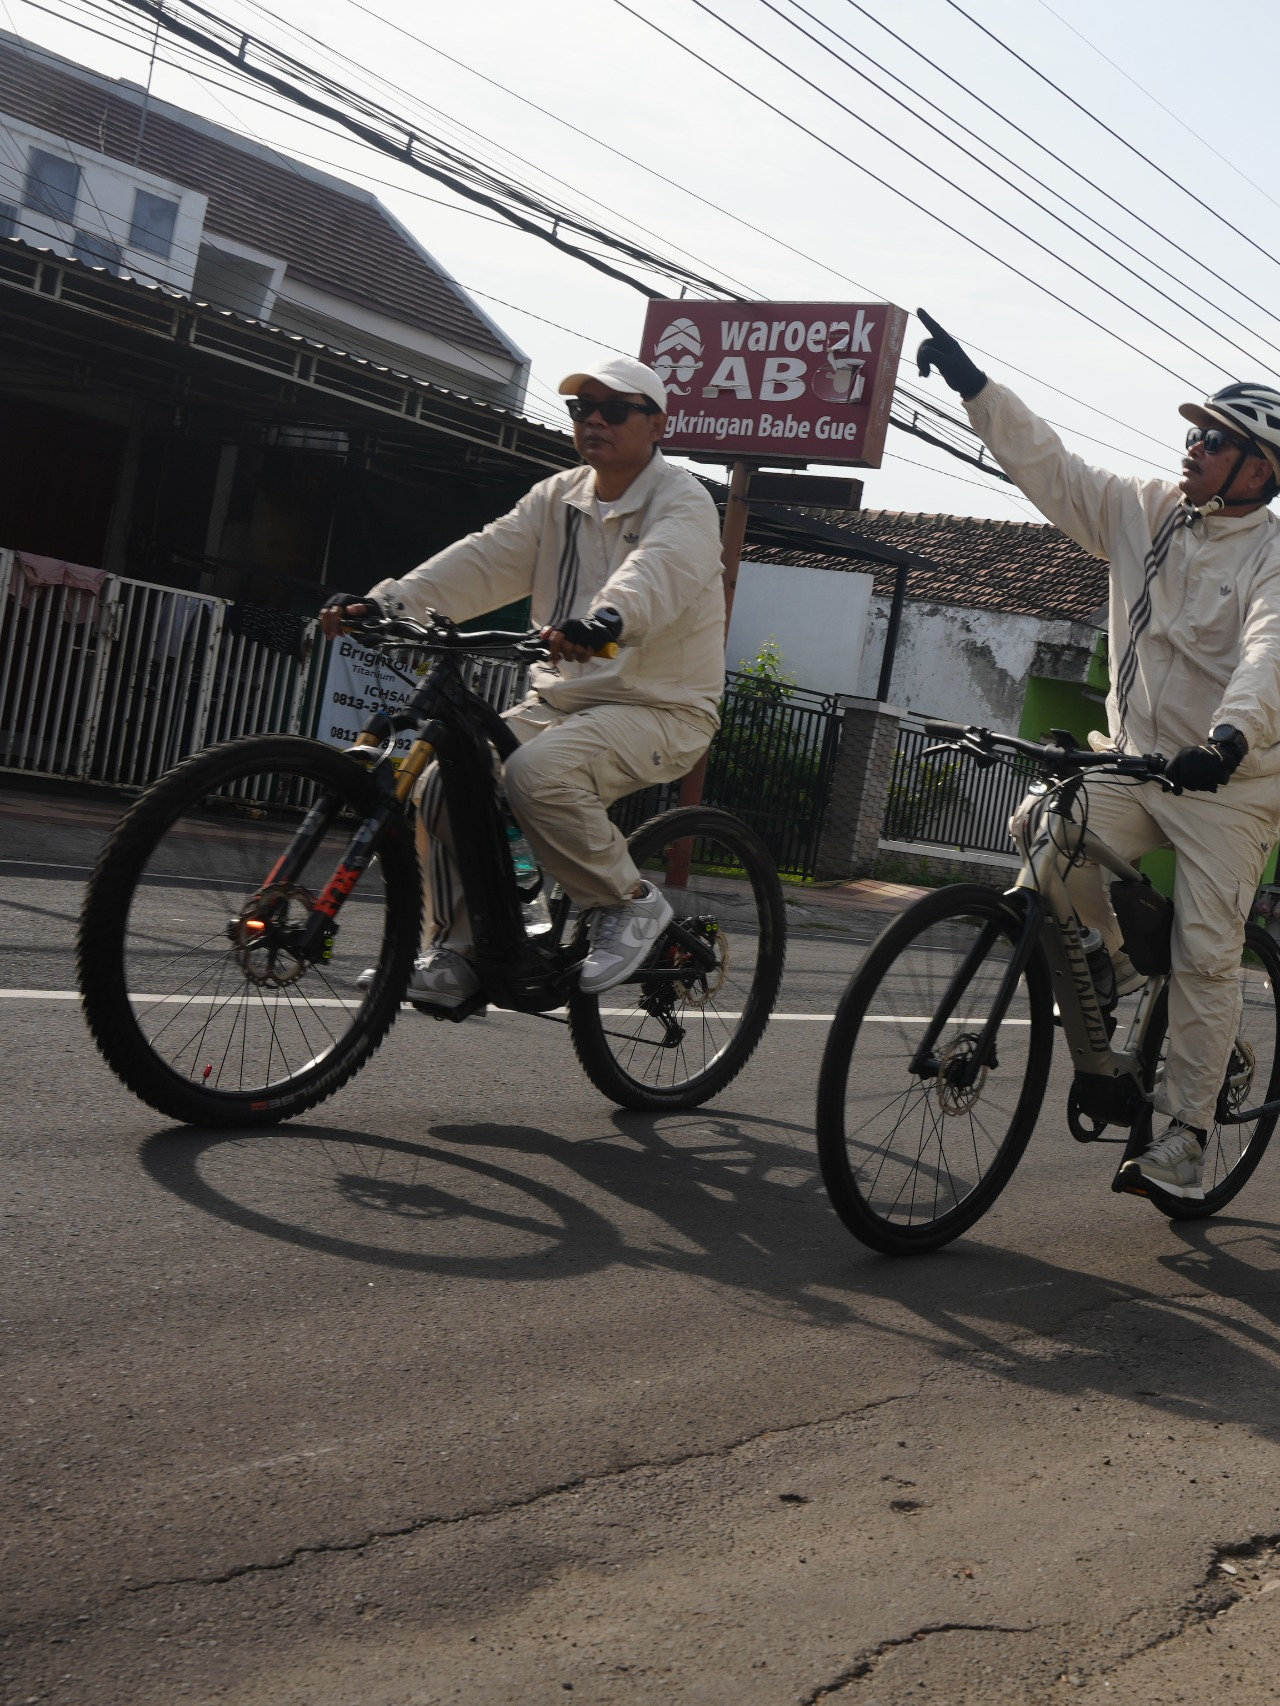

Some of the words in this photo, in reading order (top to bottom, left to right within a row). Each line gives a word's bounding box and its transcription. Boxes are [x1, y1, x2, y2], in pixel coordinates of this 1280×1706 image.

[663, 409, 754, 441] gkringan
[758, 413, 811, 439] Babe
[815, 415, 857, 441] Gue
[352, 664, 396, 682] Titanium
[1058, 915, 1109, 1053] SPECIALIZED
